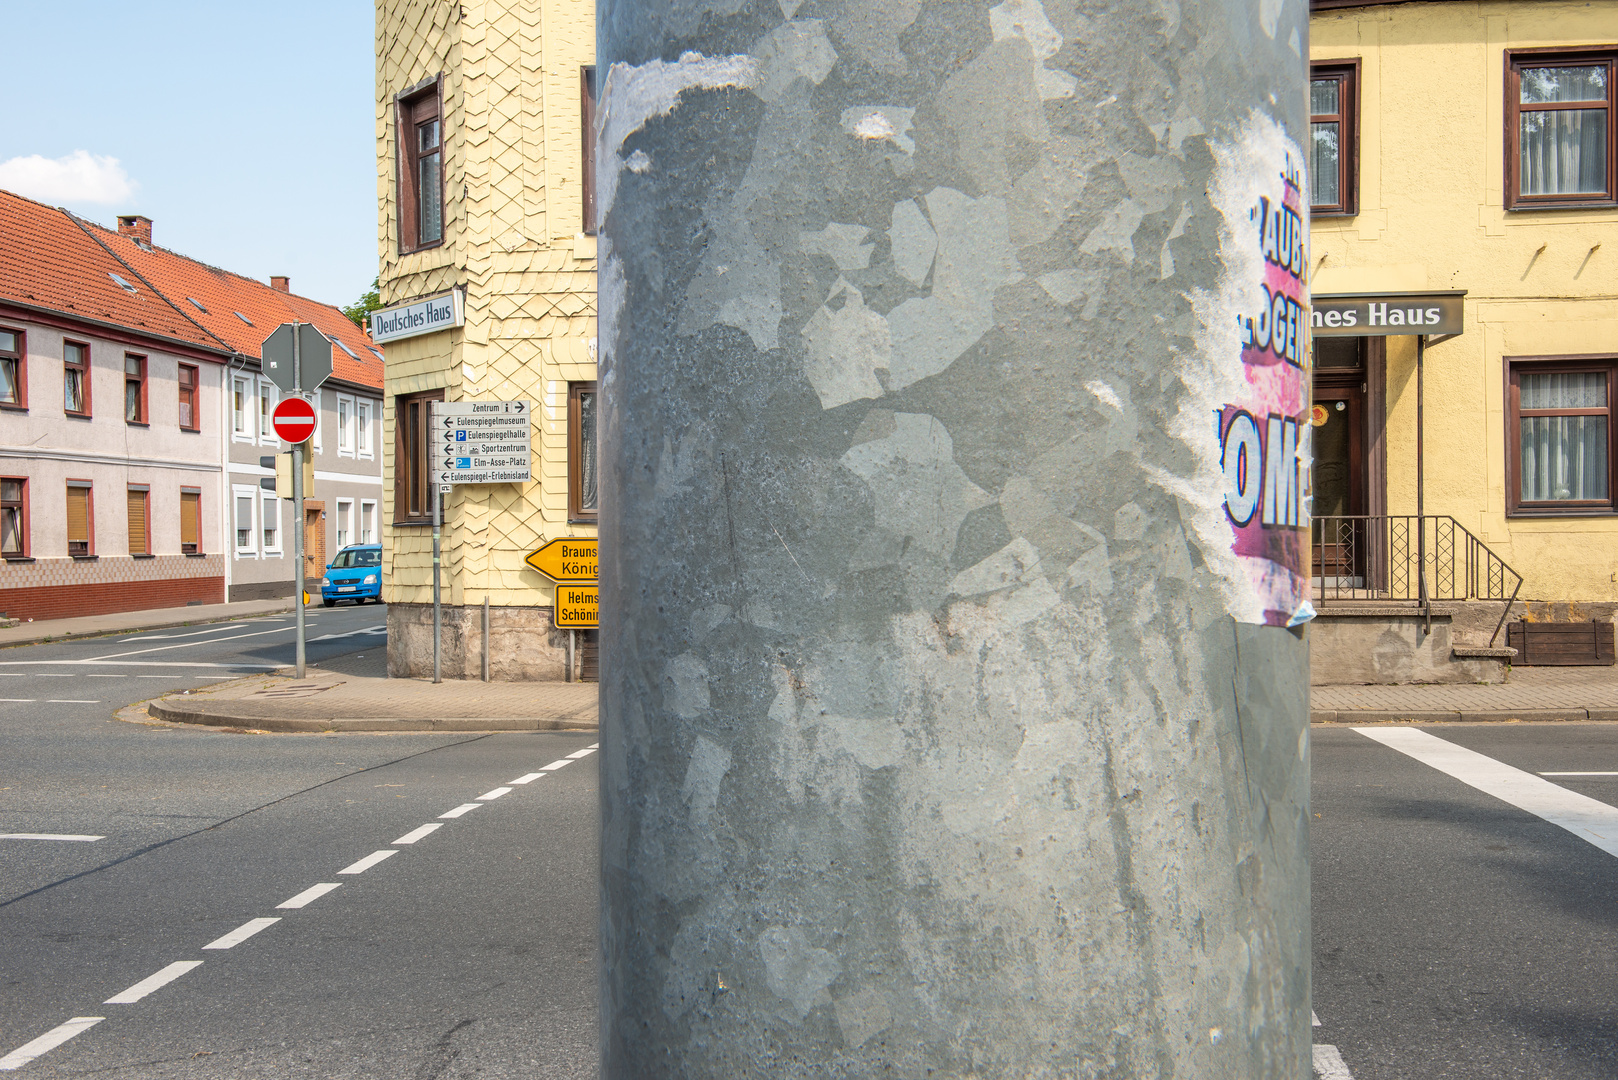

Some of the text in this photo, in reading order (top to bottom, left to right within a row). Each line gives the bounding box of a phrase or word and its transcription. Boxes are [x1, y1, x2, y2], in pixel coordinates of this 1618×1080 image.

[376, 302, 451, 335] Deutsches Haus
[1368, 302, 1441, 326] Haus
[472, 403, 500, 413] Zentrum
[457, 416, 526, 427] Eulenspiegelmuseum
[468, 430, 526, 441] Eulenspiegelhalle
[481, 444, 526, 454] Sportzentrum
[474, 457, 526, 467] Elm-Asse-Platz
[1213, 406, 1312, 530] OM
[450, 471, 529, 482] Eulenspiegel-Erlebnisland
[562, 545, 598, 558] Brauns
[562, 562, 599, 578] König
[568, 591, 599, 604] Helms
